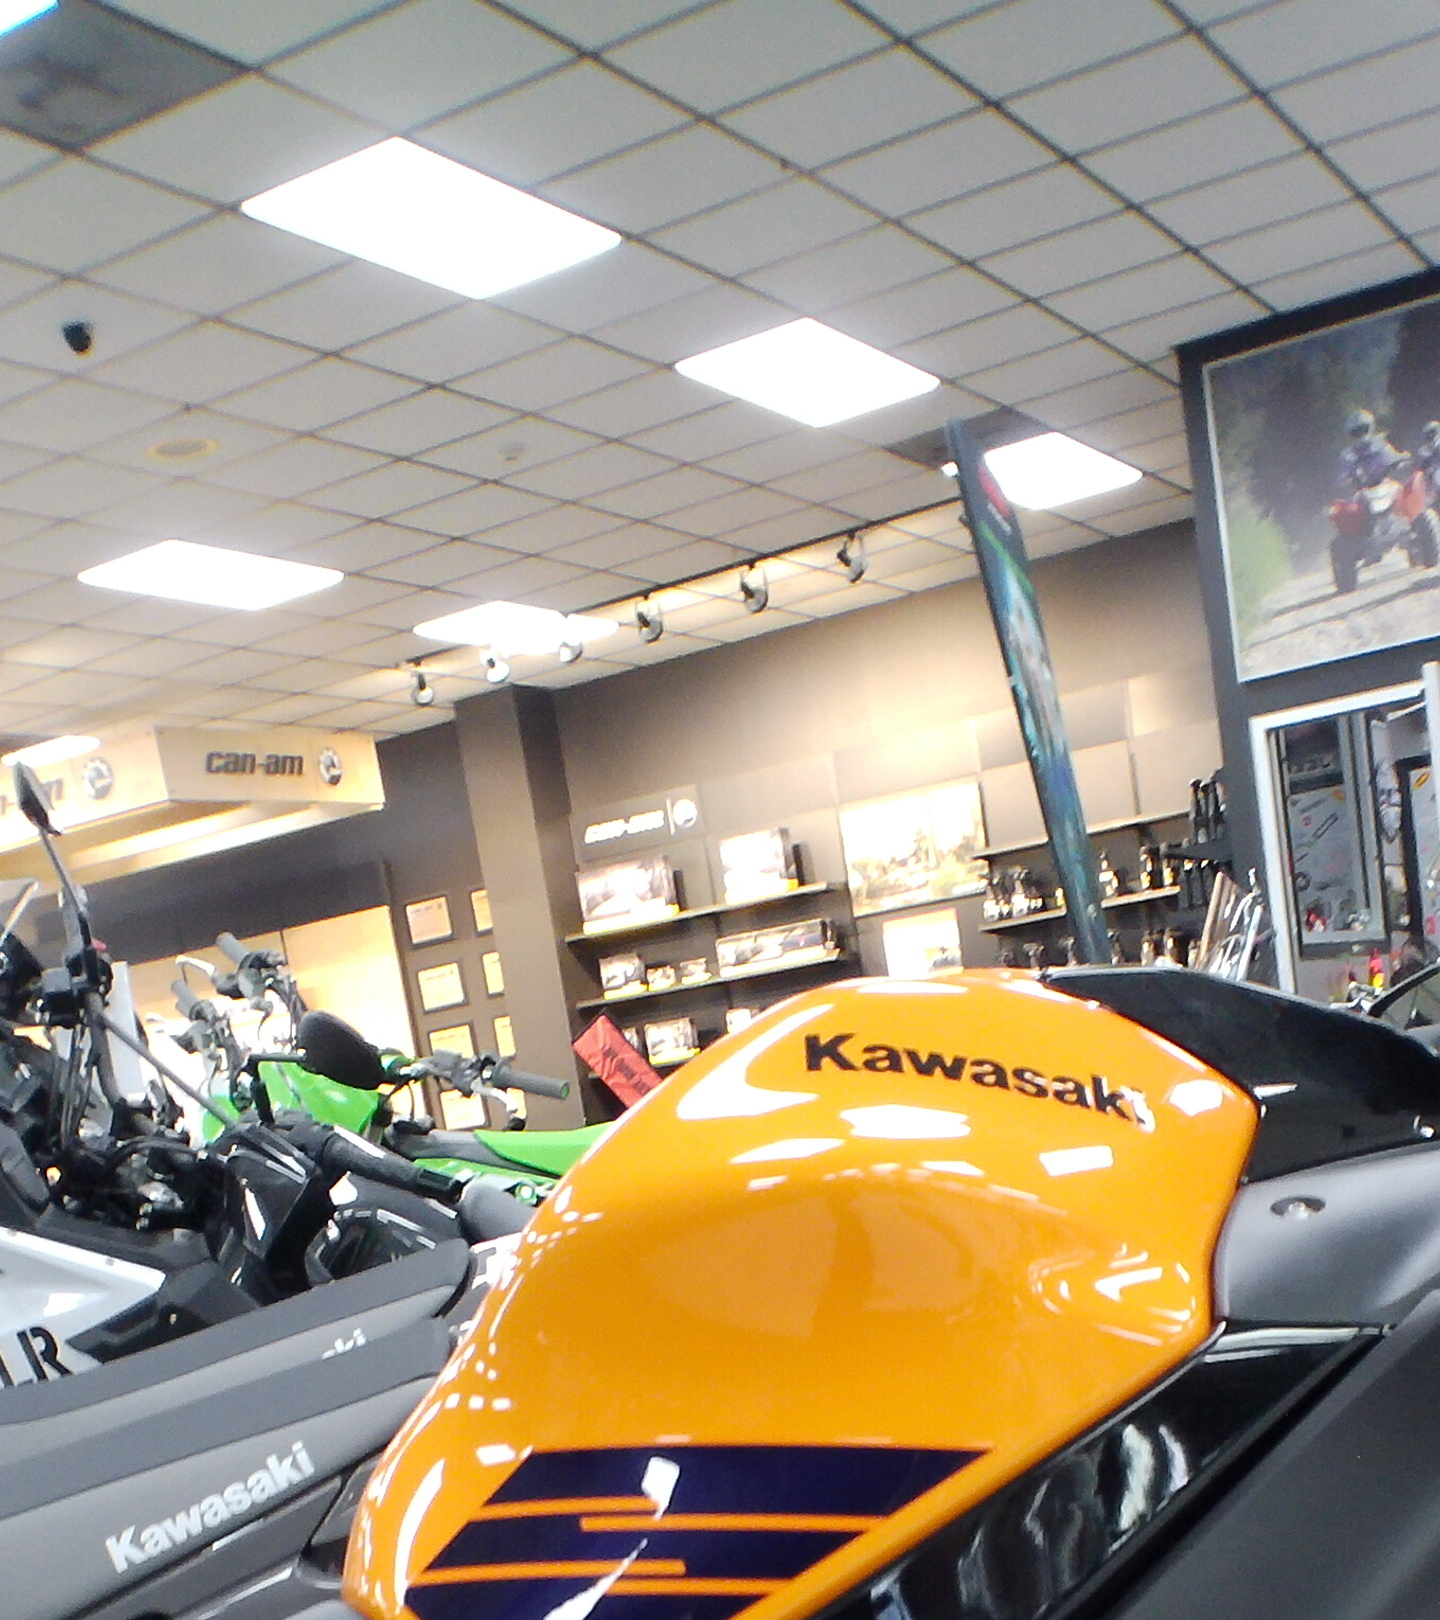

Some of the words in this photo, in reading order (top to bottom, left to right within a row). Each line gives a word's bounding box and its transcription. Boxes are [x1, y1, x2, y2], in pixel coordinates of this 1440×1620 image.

[205, 751, 303, 776] can-am
[804, 1032, 1155, 1132] Kawasak
[105, 1440, 314, 1573] Kawasaki
